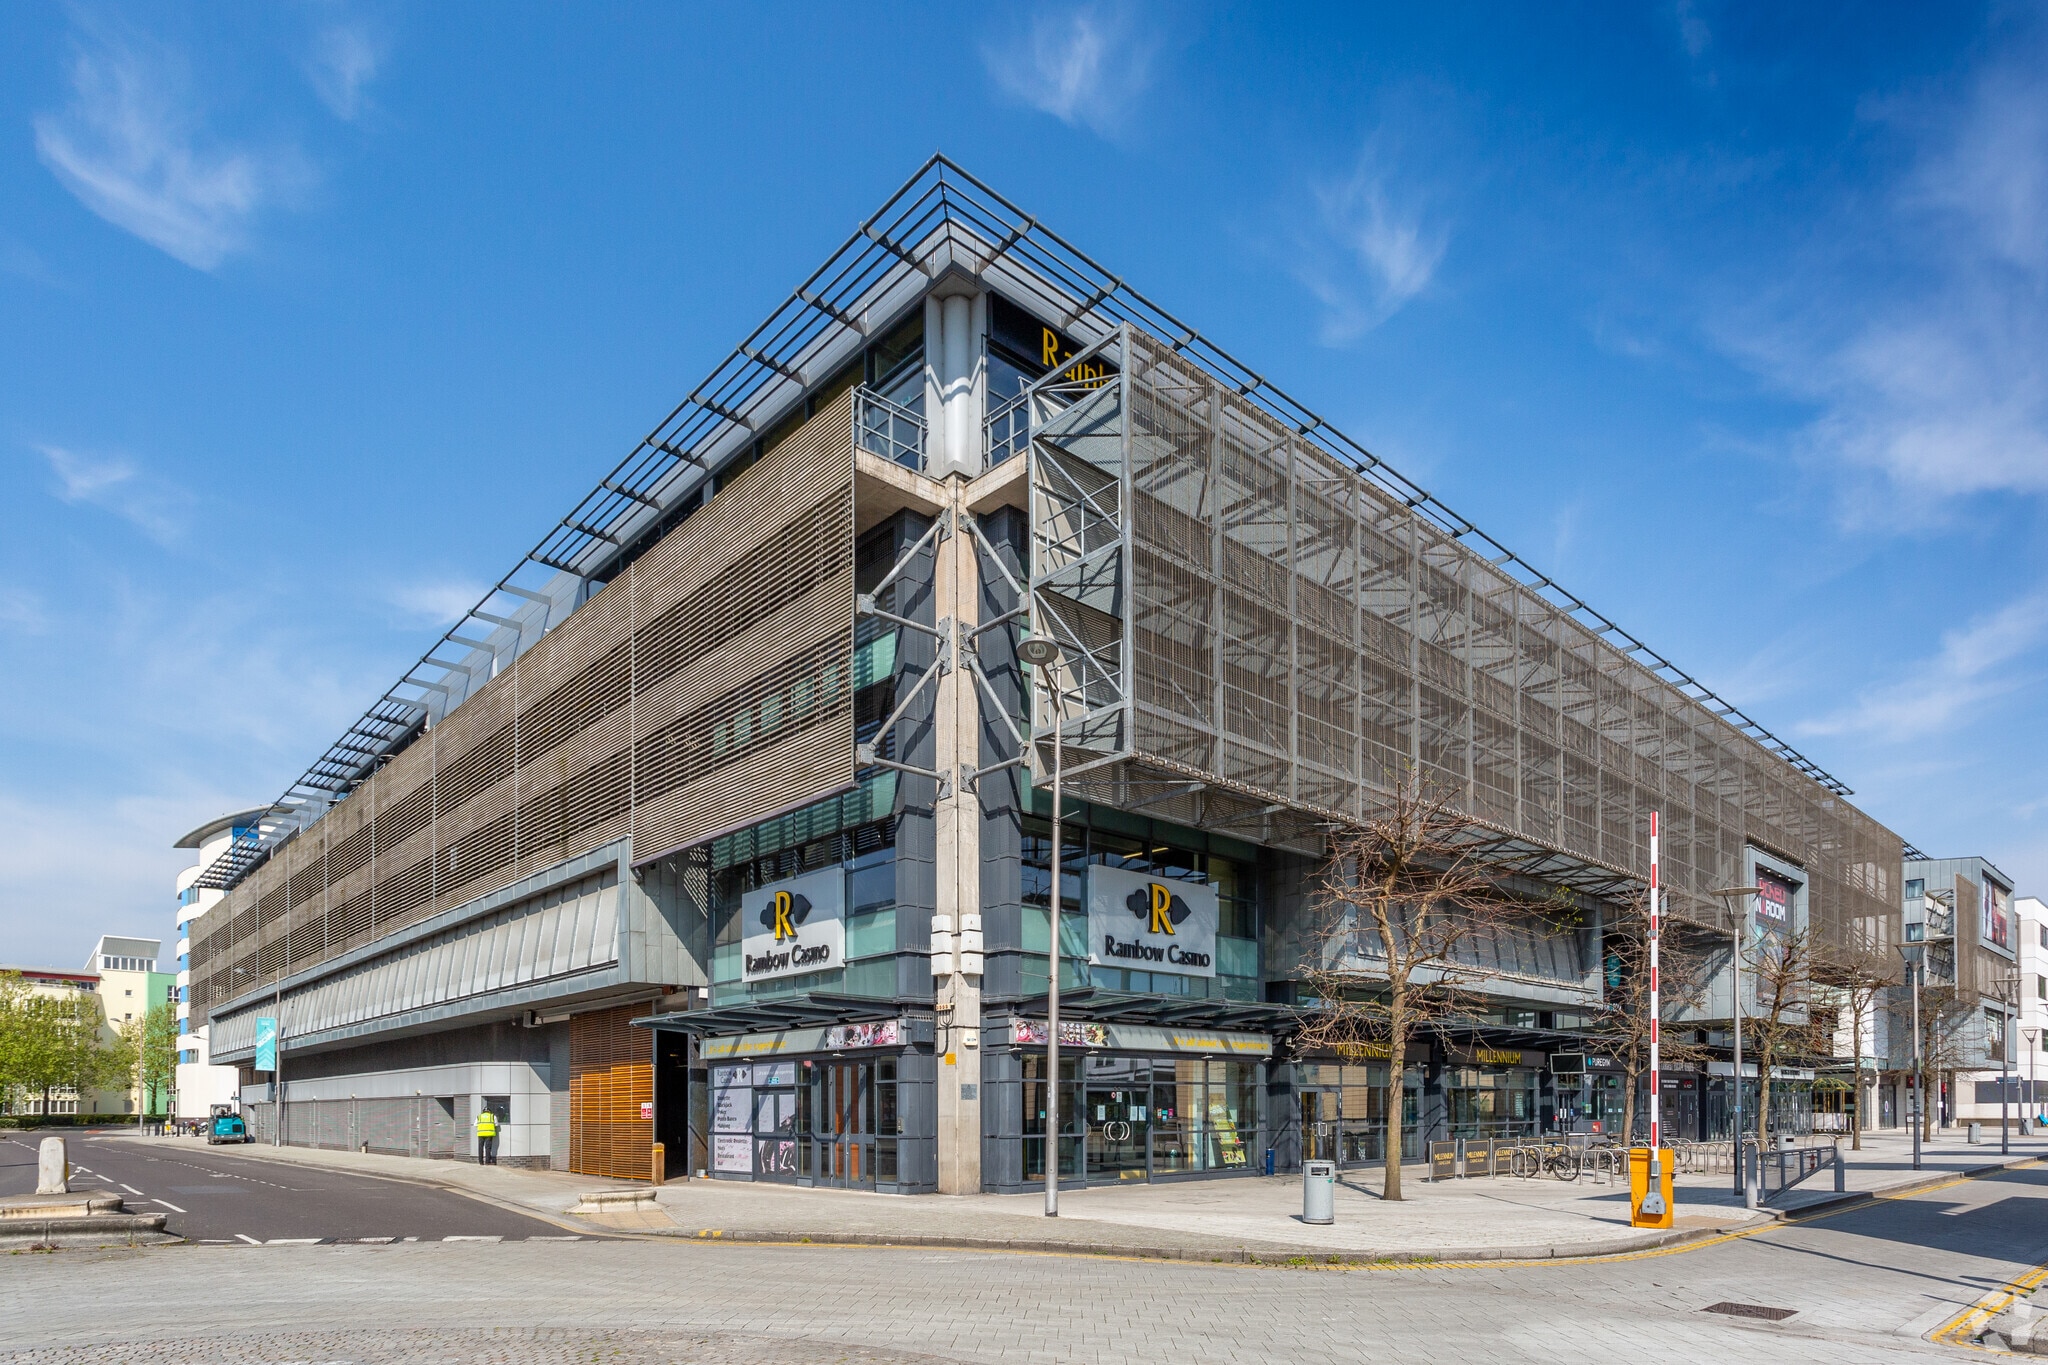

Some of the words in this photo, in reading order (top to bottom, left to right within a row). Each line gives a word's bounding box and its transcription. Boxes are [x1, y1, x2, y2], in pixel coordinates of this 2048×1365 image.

[775, 891, 798, 941] R
[1148, 883, 1175, 935] R
[1105, 935, 1164, 962] Rainbow
[1168, 944, 1211, 967] Casino
[1476, 1049, 1521, 1064] MILLENNIUM
